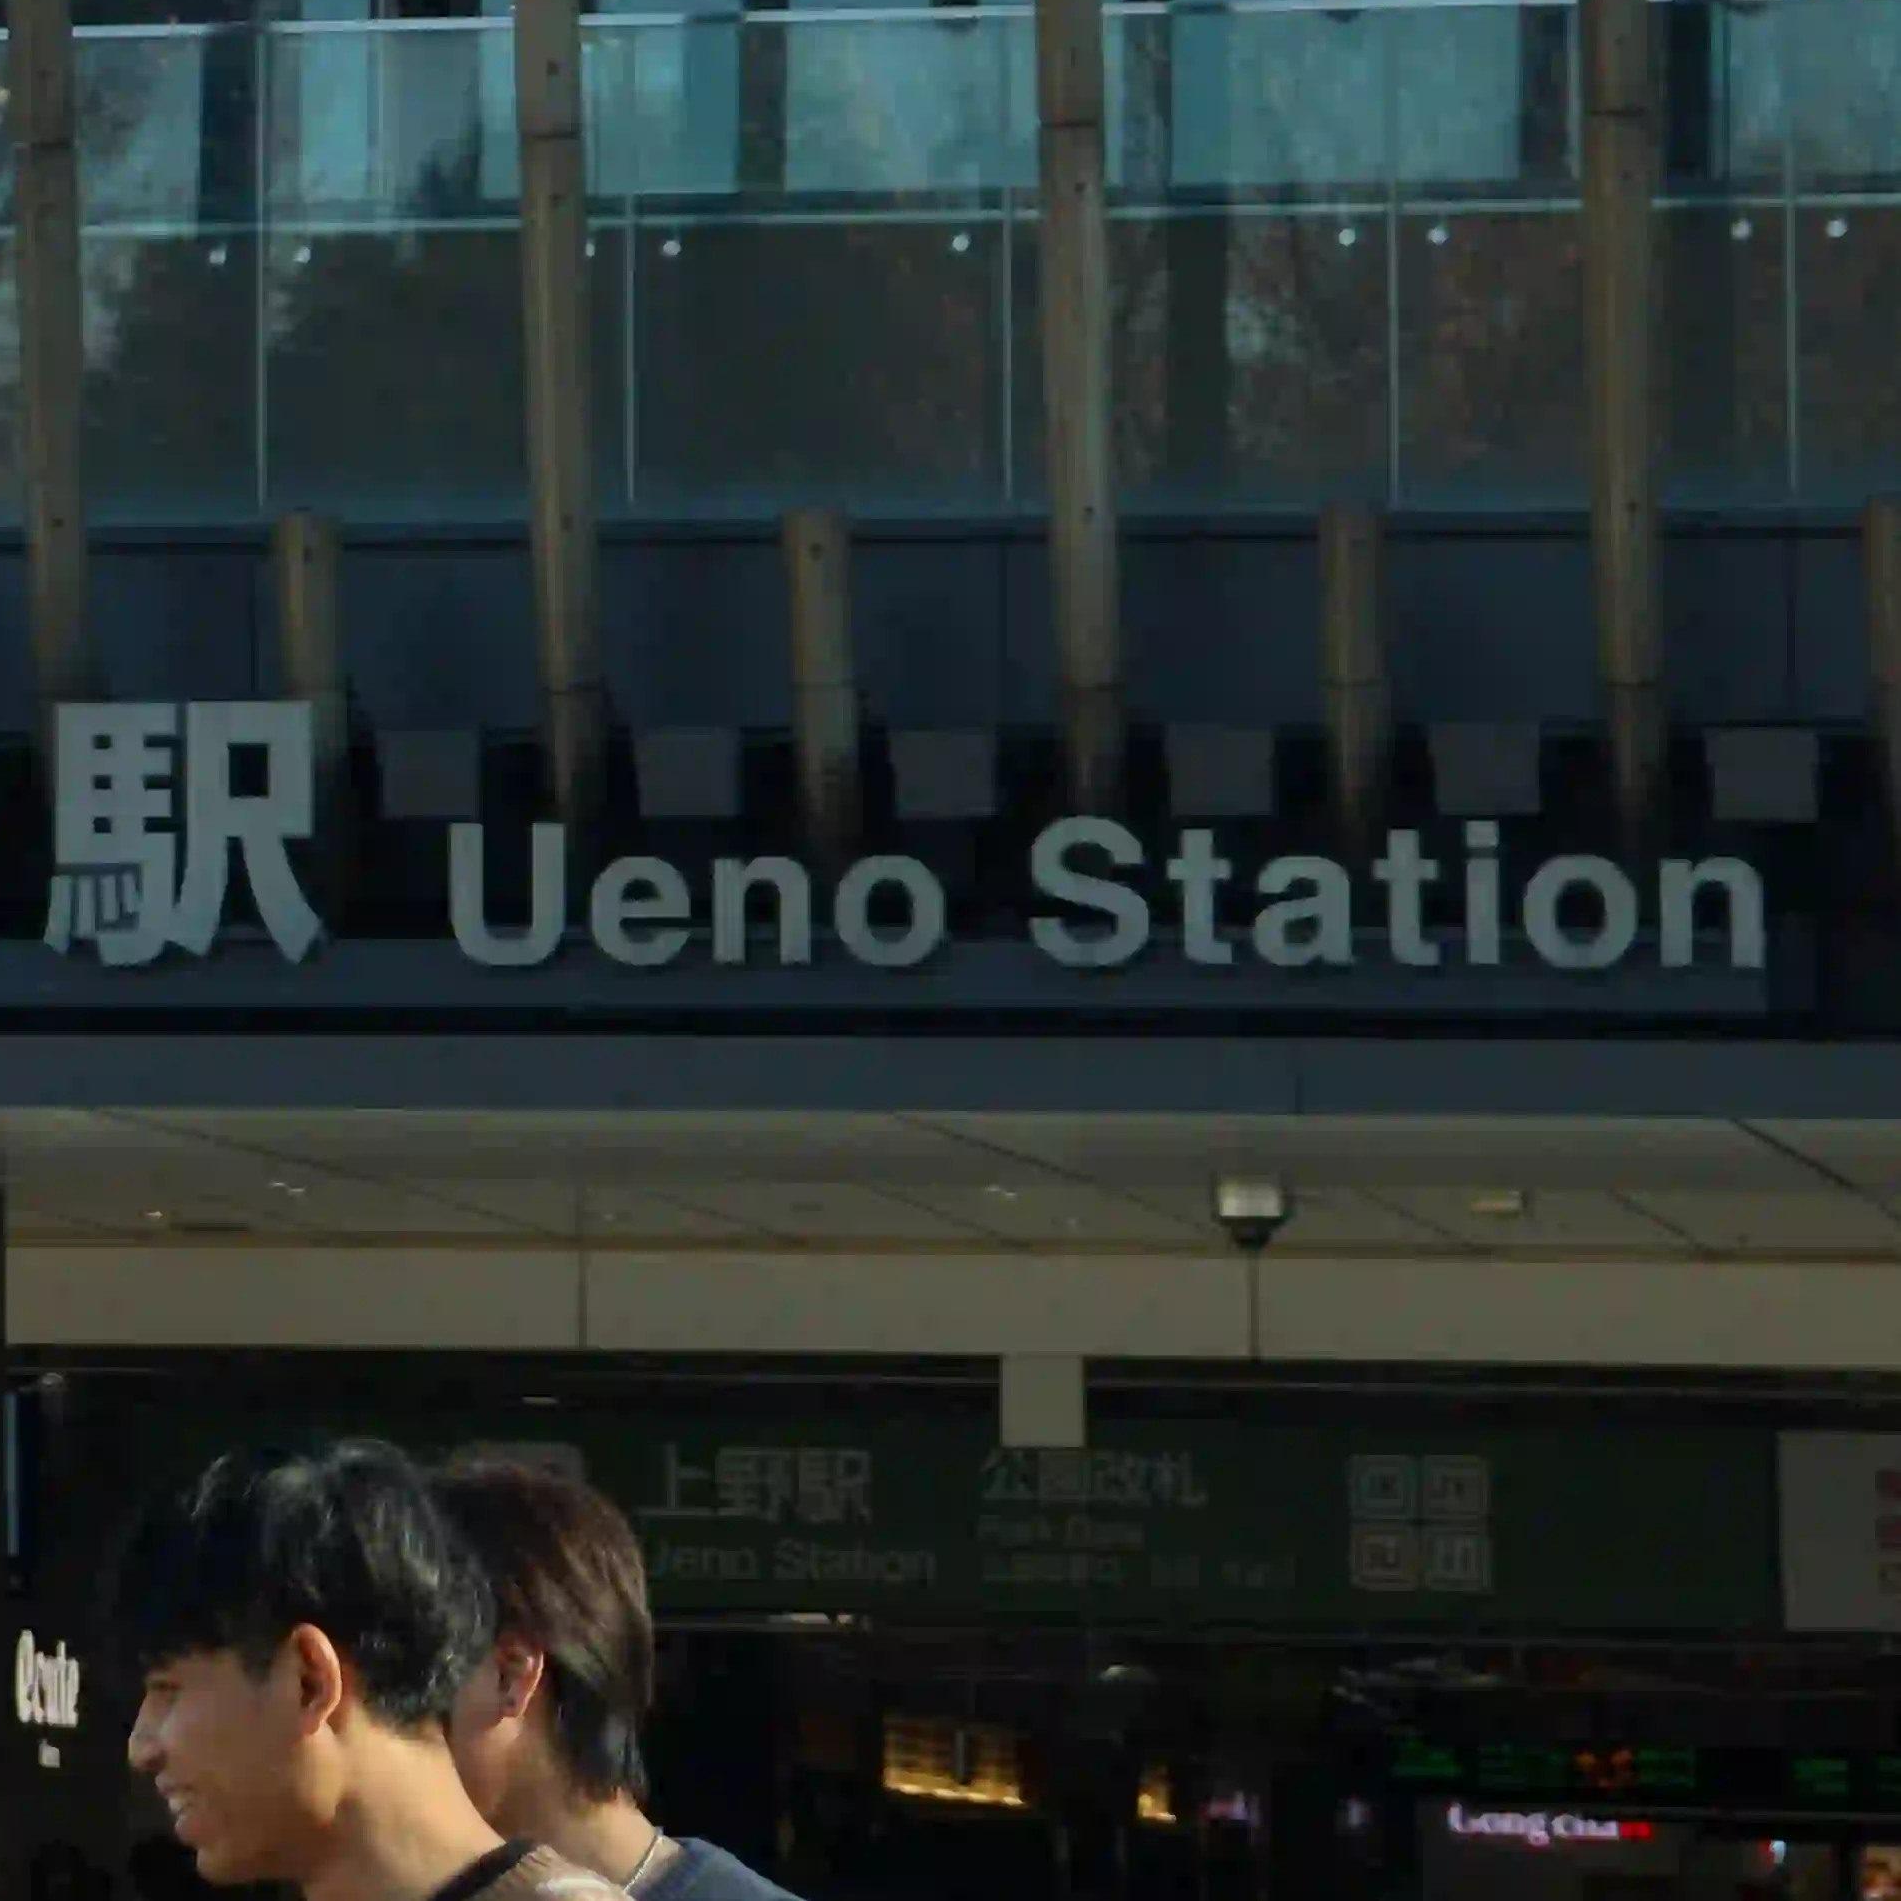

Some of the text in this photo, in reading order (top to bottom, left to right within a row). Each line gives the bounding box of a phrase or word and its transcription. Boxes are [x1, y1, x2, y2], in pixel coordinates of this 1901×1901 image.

[447, 821, 948, 969] Ueno
[1029, 814, 1766, 969] Station
[632, 1441, 873, 1524] 上野駅
[978, 1447, 1209, 1507] 公園改札
[774, 1536, 937, 1580] Station
